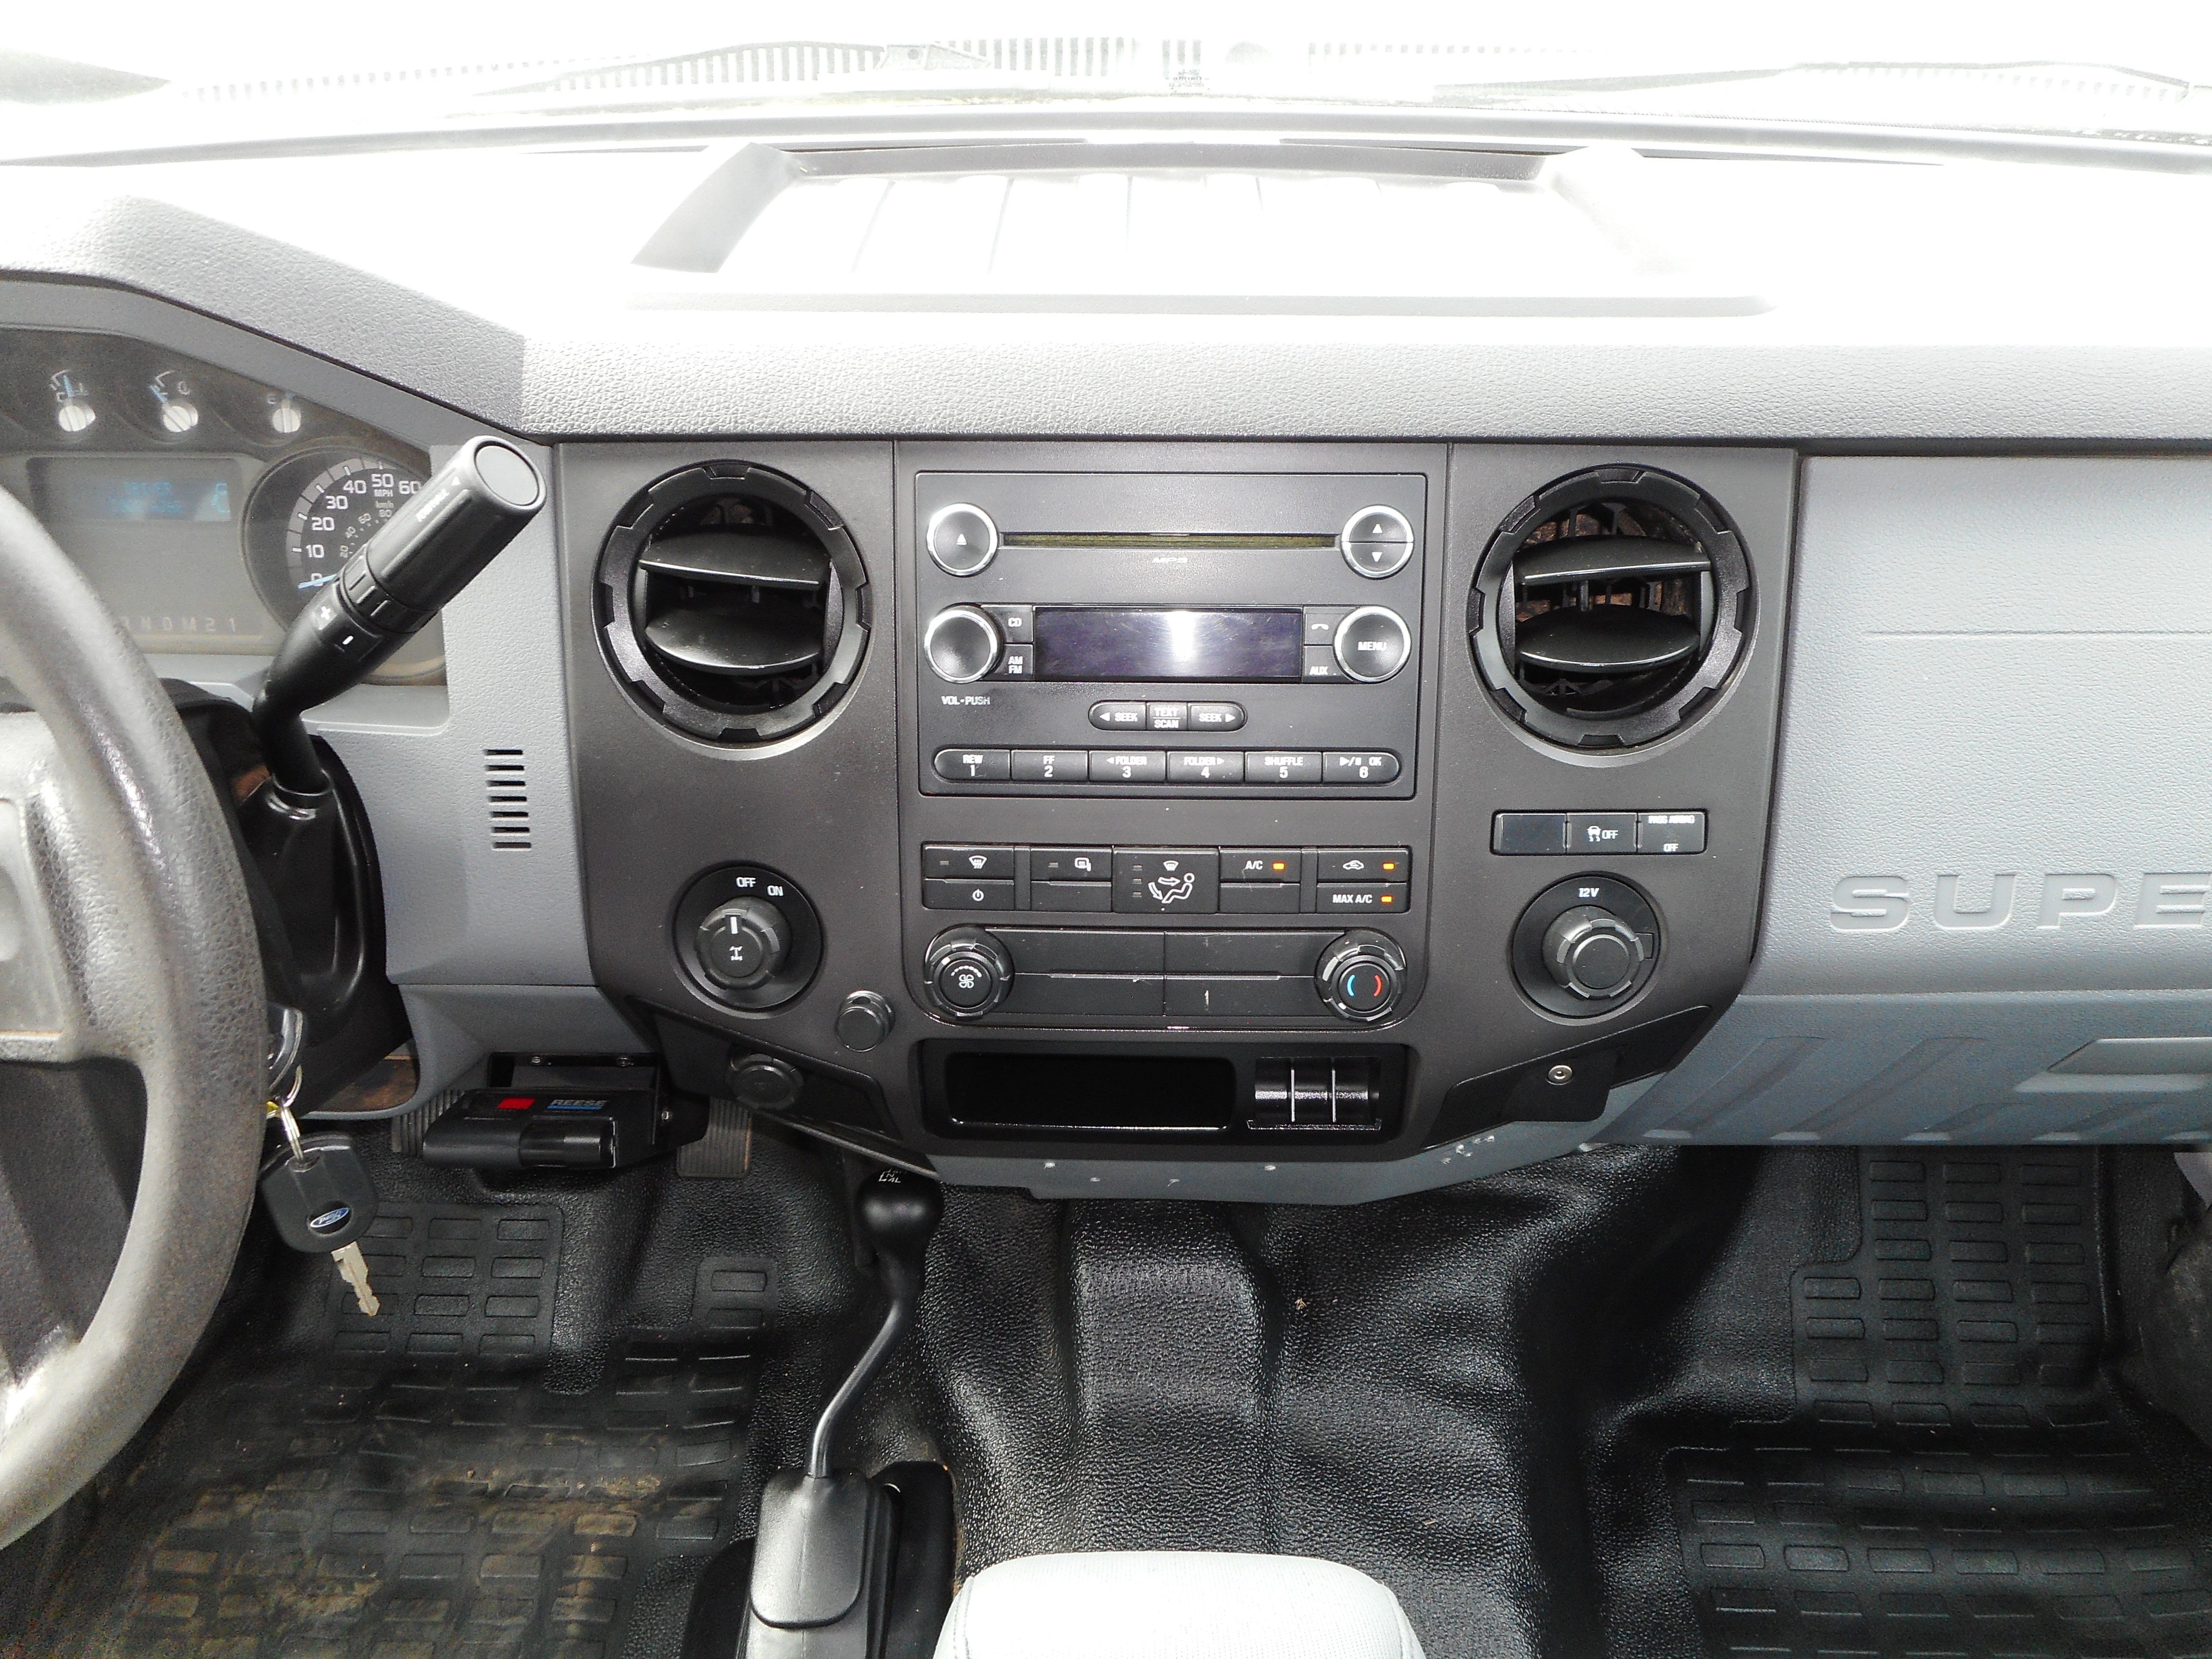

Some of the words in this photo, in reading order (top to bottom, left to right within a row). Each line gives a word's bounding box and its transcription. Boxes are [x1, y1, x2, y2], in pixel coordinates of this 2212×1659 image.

[371, 474, 394, 487] 50
[343, 480, 367, 494] 40
[398, 481, 421, 495] 60
[374, 489, 393, 497] MPH
[325, 495, 348, 510] 30
[358, 513, 371, 524] 60
[311, 517, 335, 531] 20
[306, 544, 324, 558] 10
[1008, 617, 1022, 627] CD
[1358, 641, 1387, 651] MENU
[1008, 656, 1023, 665] AM
[1008, 665, 1023, 674] FM
[1310, 666, 1328, 675] AUX
[1115, 712, 1138, 722] SEEK
[1154, 707, 1179, 717] TEXT
[1198, 712, 1222, 722] SEEK
[1154, 719, 1179, 728] SCAN
[963, 754, 983, 764] REW
[1043, 756, 1055, 765] FF
[1115, 756, 1148, 766] FOLDER
[1184, 757, 1216, 766] FOLDER
[1264, 757, 1303, 766] SHUFFLE
[1369, 757, 1381, 766] OK
[970, 765, 975, 776] 1
[1044, 766, 1053, 778] 2
[1122, 766, 1131, 778] 3
[1201, 766, 1210, 778] 4
[1279, 766, 1288, 778] 5
[1359, 766, 1368, 778] 6
[1601, 830, 1619, 839] OFF
[1663, 843, 1679, 852] OFF
[1246, 860, 1263, 870] A/C
[736, 877, 757, 887] OFF
[767, 885, 784, 896] ON
[1579, 887, 1600, 897] 12V
[1332, 894, 1353, 903] MAX
[1355, 894, 1373, 903] A/C
